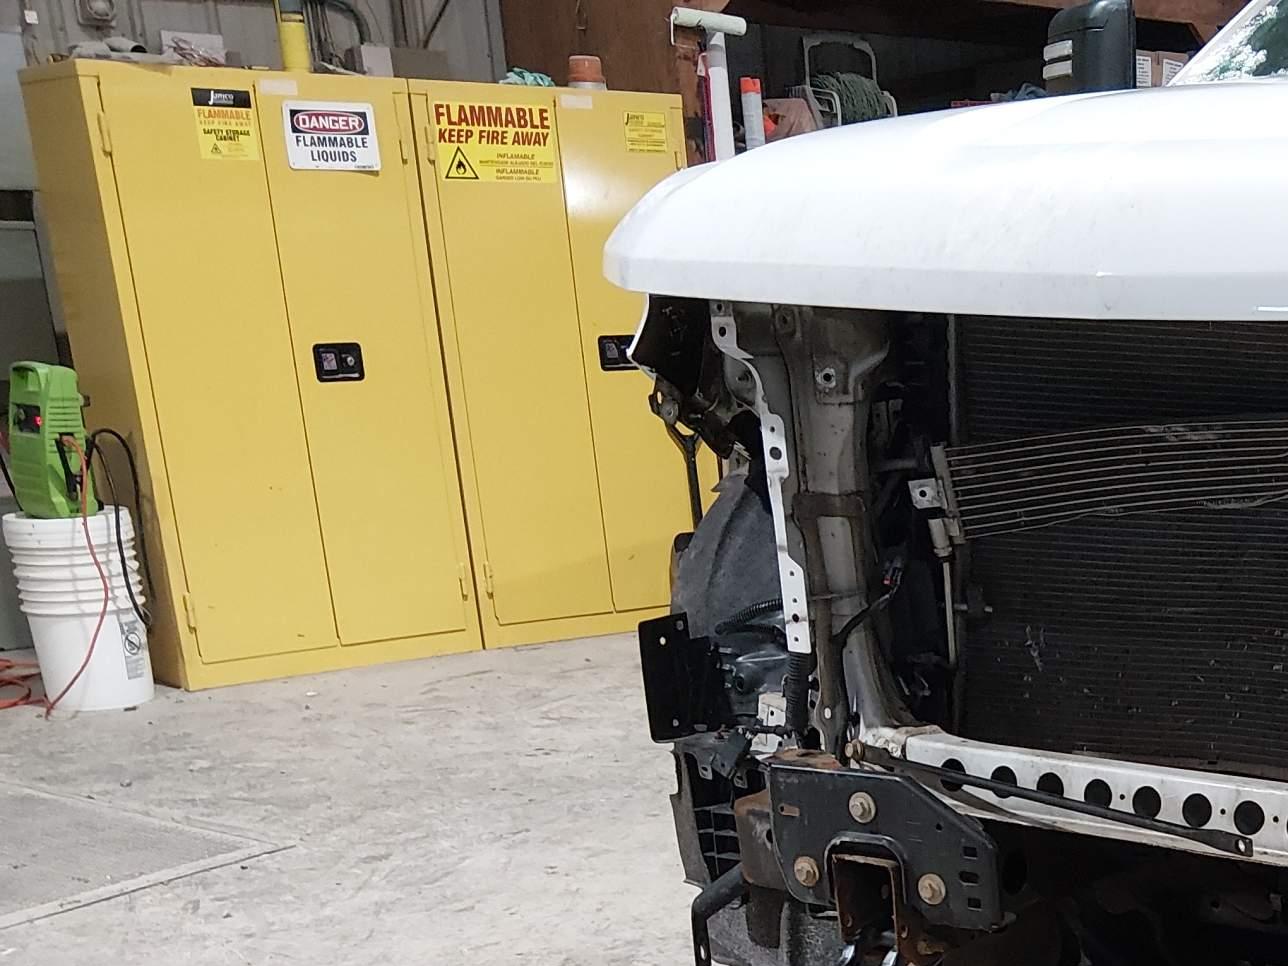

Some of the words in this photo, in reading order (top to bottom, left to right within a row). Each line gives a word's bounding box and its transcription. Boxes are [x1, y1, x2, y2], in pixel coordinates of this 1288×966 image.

[197, 108, 252, 120] FLAMMABLE
[434, 104, 551, 130] FLAMMABLE
[299, 115, 360, 130] DANGER
[295, 135, 369, 149] FLAMMABLE
[438, 128, 474, 144] KEEP
[478, 129, 508, 145] FIRE
[512, 131, 550, 147] AWAY
[310, 150, 358, 163] LIQUIDS
